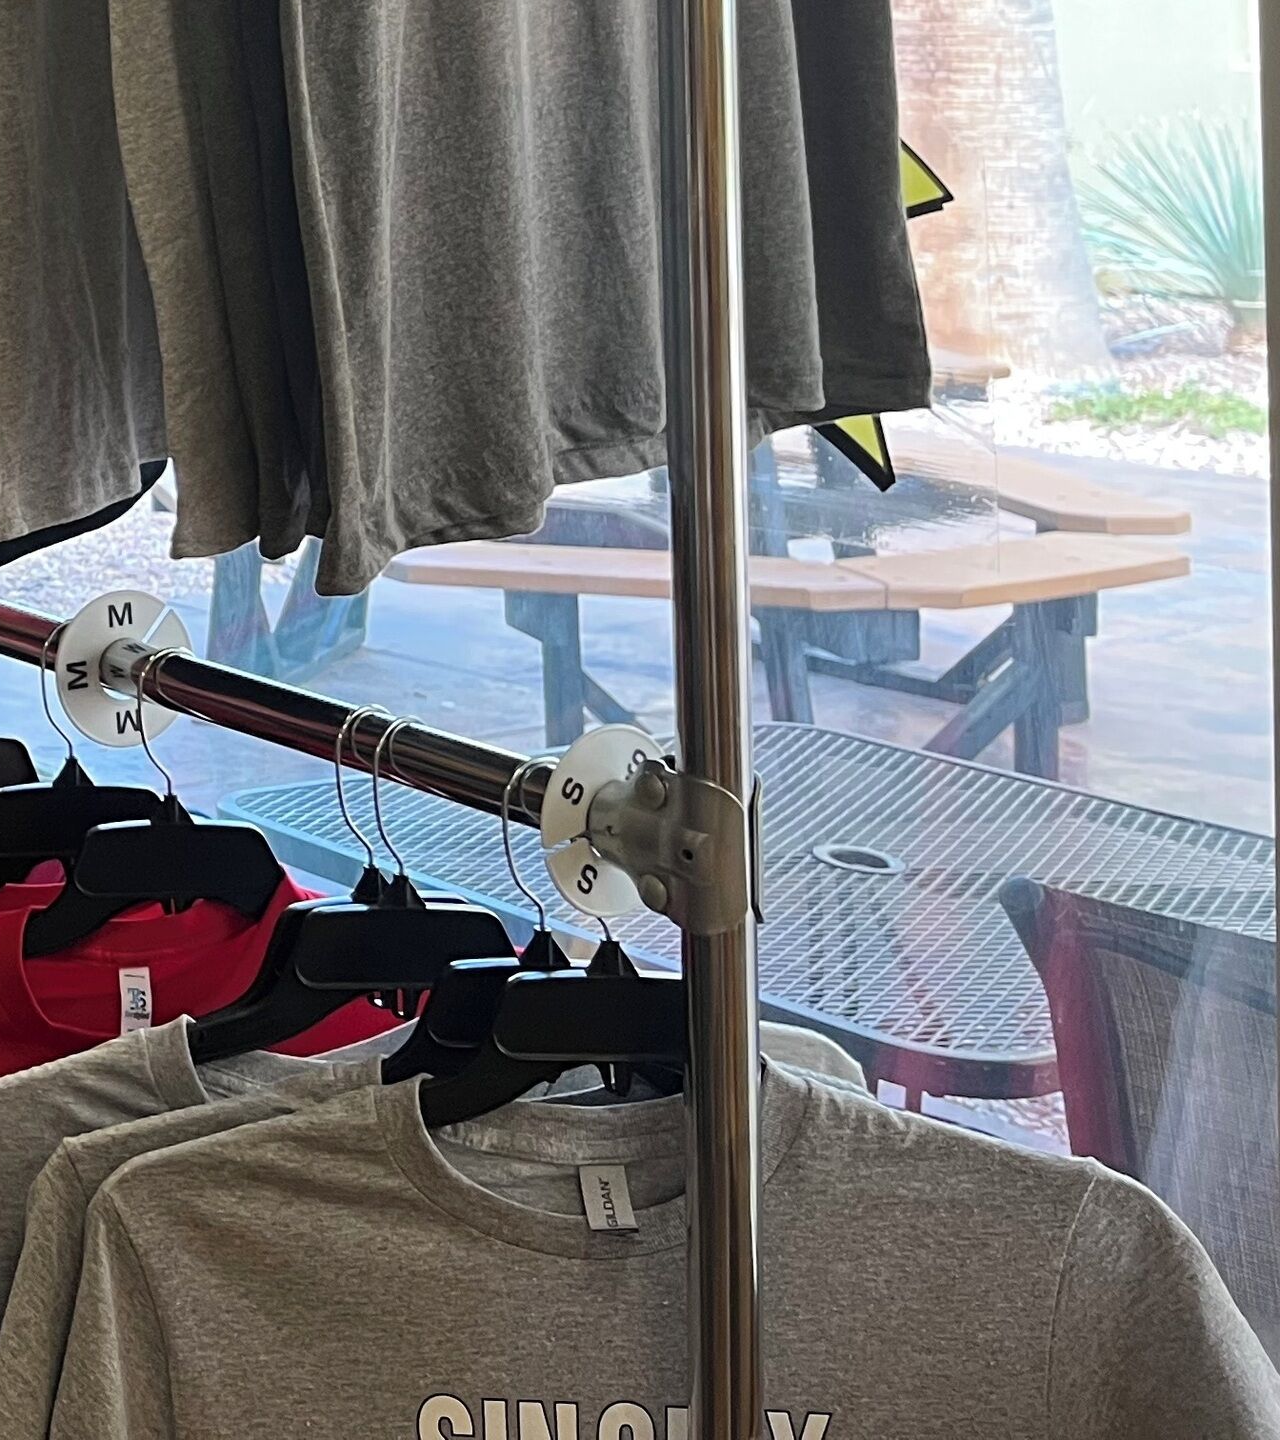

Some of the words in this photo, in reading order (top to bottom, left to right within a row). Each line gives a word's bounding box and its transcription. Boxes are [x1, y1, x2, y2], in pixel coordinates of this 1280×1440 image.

[107, 601, 133, 628] M
[66, 660, 89, 691] M
[561, 776, 585, 806] S
[577, 863, 598, 895] S
[598, 1176, 619, 1228] GILDAN
